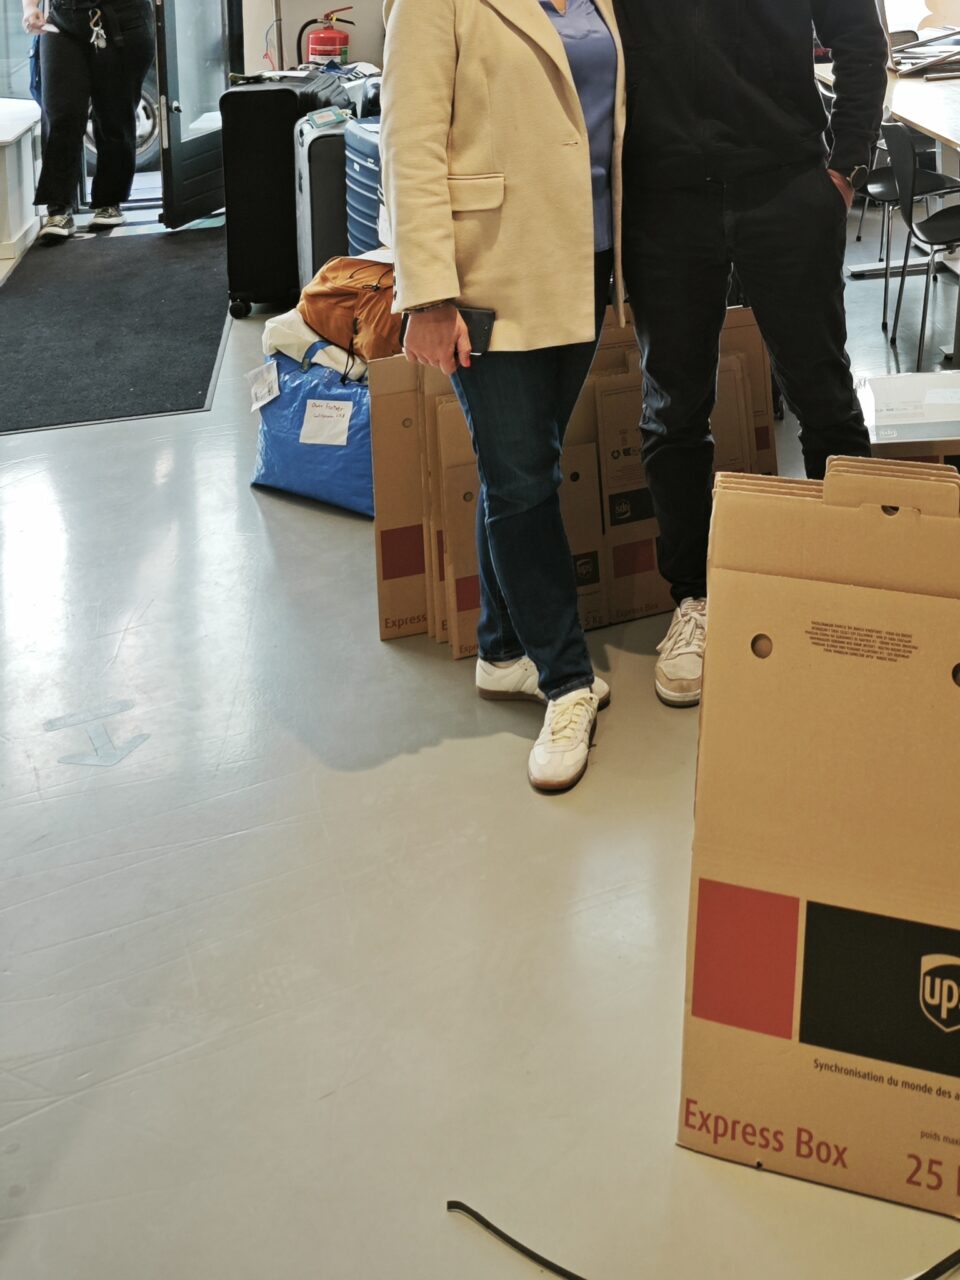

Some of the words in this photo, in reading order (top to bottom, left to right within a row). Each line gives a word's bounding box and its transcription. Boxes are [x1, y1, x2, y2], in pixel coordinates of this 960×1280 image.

[384, 614, 427, 630] Express
[813, 1058, 885, 1084] Synchronisation
[886, 1074, 899, 1088] du
[900, 1078, 934, 1095] monde
[935, 1086, 952, 1099] des
[684, 1097, 785, 1153] Express
[795, 1126, 848, 1170] Box
[920, 1129, 941, 1142] poids
[905, 1153, 944, 1192] 25
